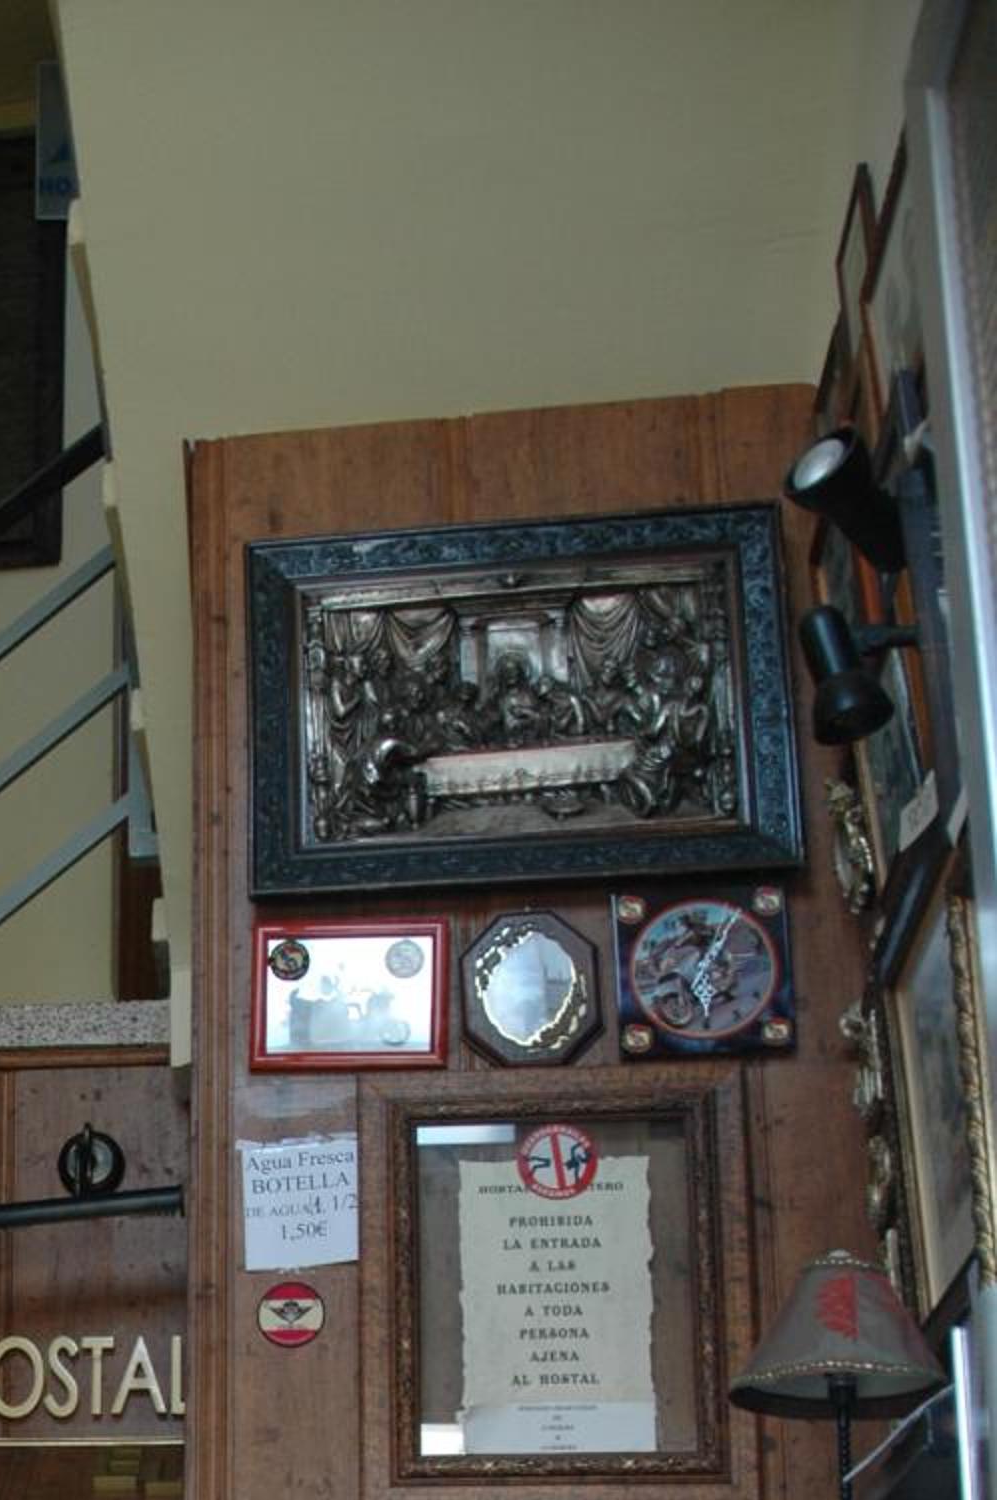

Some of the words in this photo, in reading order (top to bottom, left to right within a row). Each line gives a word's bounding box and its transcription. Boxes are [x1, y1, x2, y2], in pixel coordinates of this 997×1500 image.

[248, 1156, 292, 1175] Agua
[298, 1151, 354, 1167] Fresca
[252, 1171, 350, 1194] BOTELLA
[478, 1184, 527, 1195] HOSTA
[246, 1206, 262, 1217] DE
[509, 1215, 594, 1228] PROHIBIDA
[282, 1219, 328, 1241] 1,50€
[503, 1239, 522, 1250] LA
[530, 1237, 603, 1249] ENTRADA
[529, 1260, 540, 1272] A
[548, 1260, 577, 1272] LAS
[497, 1281, 611, 1295] HABITACIONES
[524, 1305, 534, 1317] A
[541, 1304, 584, 1317] TODA
[519, 1327, 590, 1340] PERSONA
[530, 1350, 580, 1363] AJENA
[511, 1374, 532, 1386] AL
[539, 1373, 600, 1385] HOSTAL
